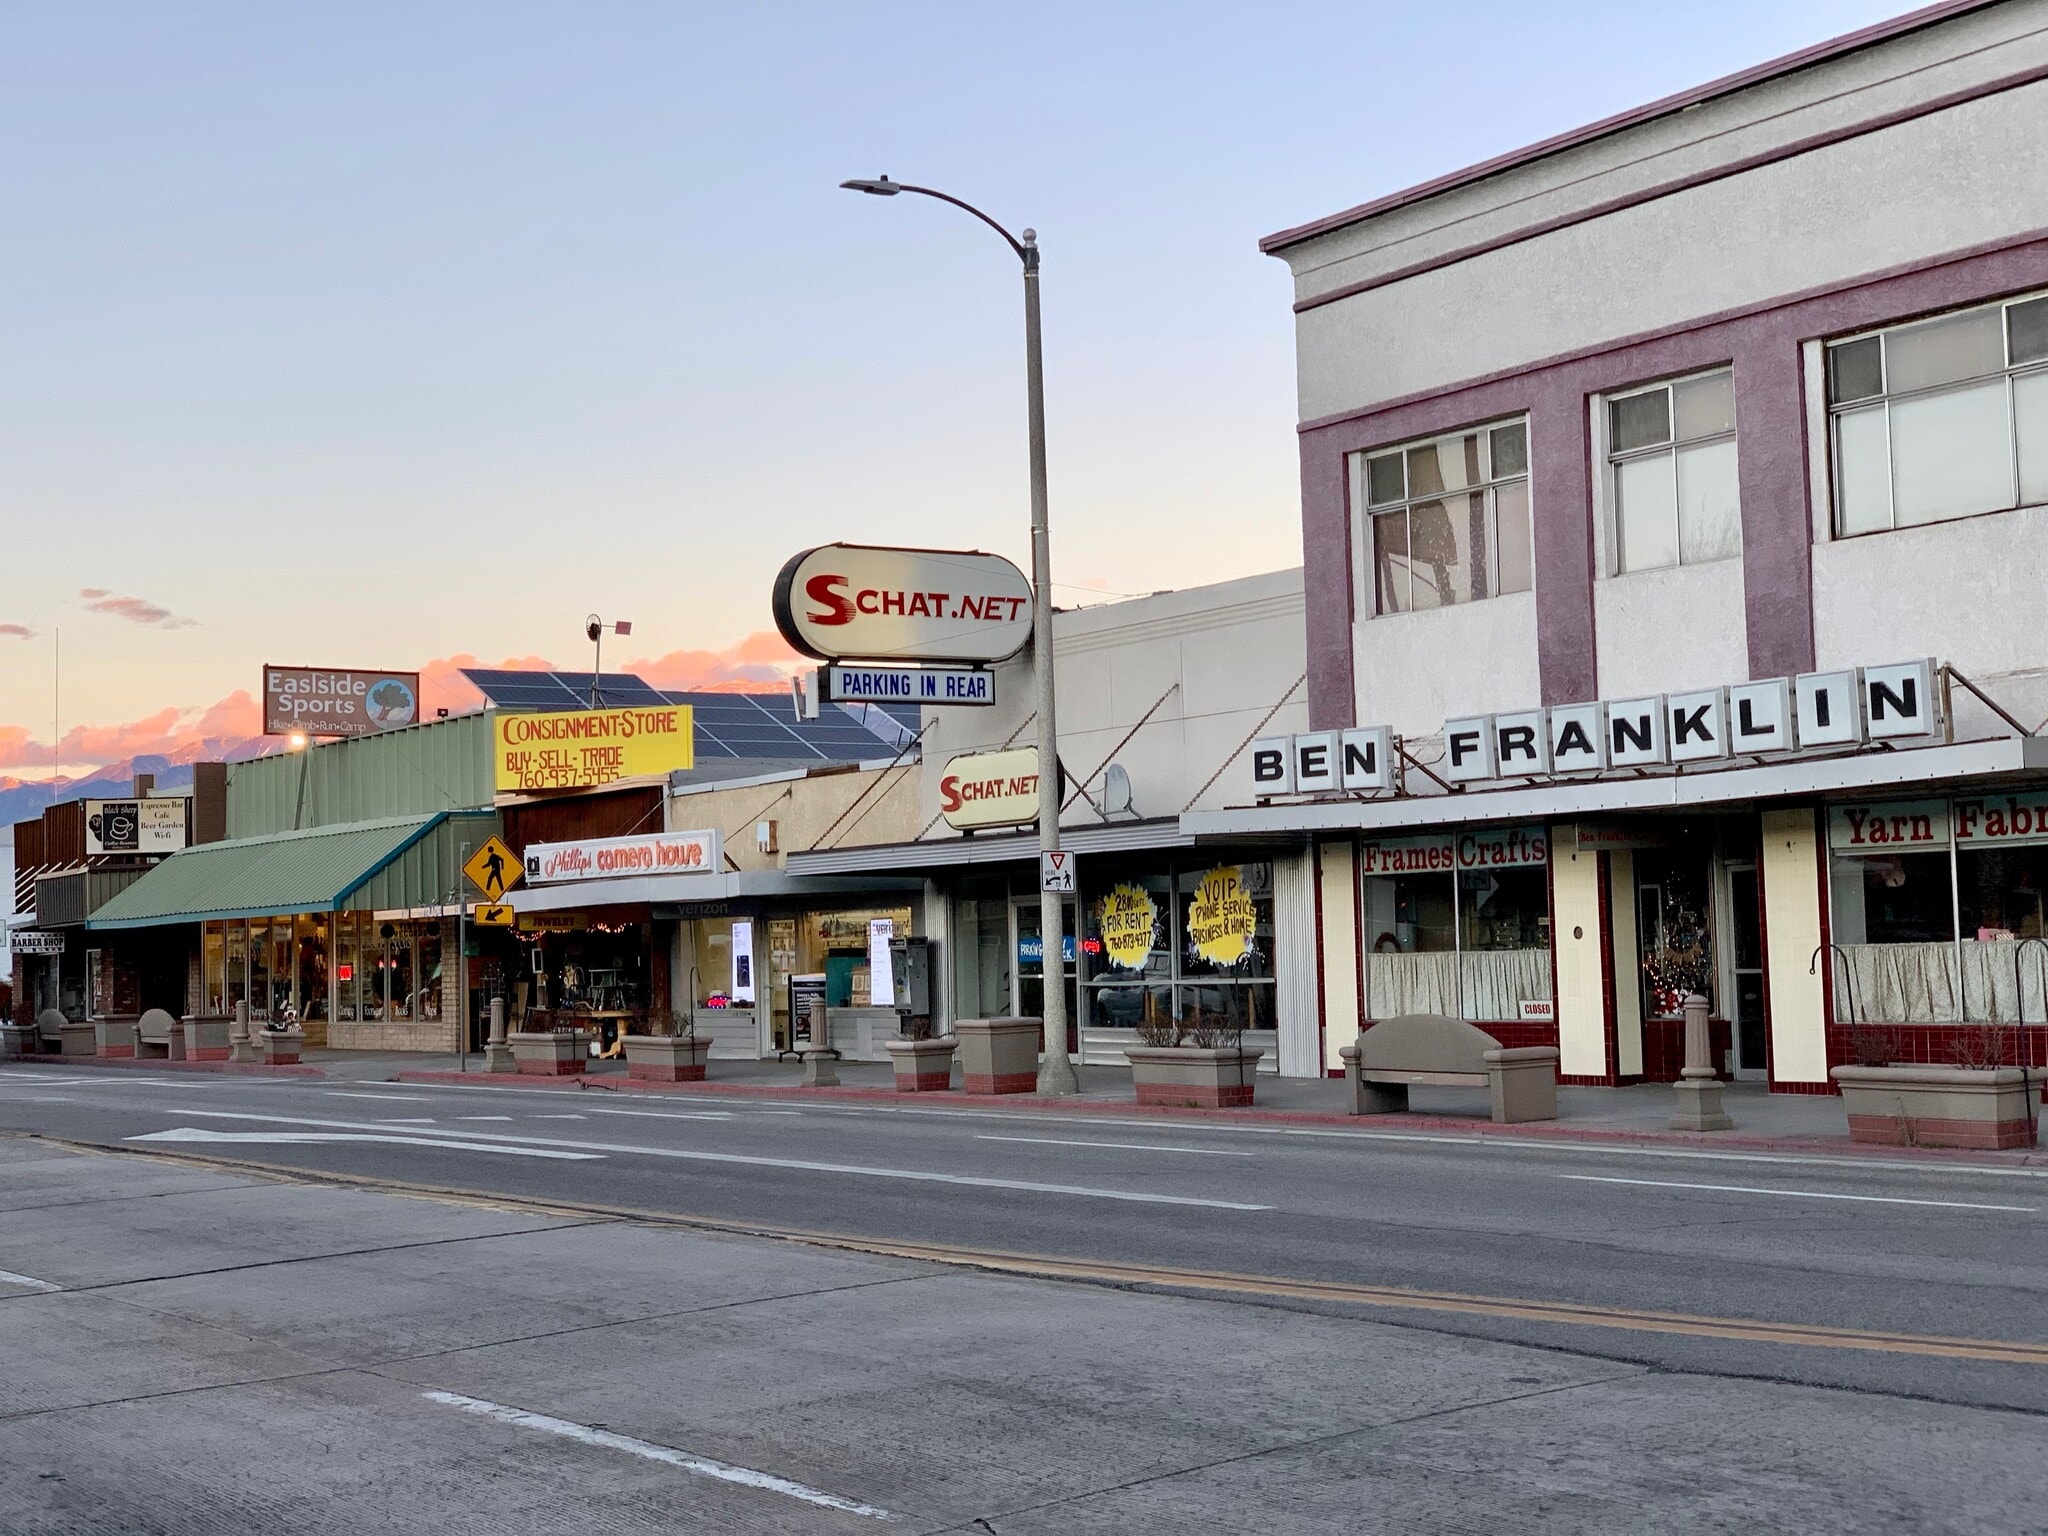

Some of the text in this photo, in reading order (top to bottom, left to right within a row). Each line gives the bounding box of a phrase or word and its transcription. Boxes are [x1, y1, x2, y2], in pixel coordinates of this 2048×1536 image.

[805, 574, 1027, 626] SCHAT.NET
[268, 672, 367, 696] Eastside
[842, 673, 986, 698] PARKING IN REAR
[278, 694, 356, 719] Sports
[1254, 677, 1919, 781] BEN FRANKLIN
[514, 766, 620, 789] 760-937-5455
[940, 775, 1040, 812] SCHAT.NET
[158, 821, 184, 829] Garden
[1843, 807, 1934, 844] Yarn
[544, 840, 703, 878] Phillips camera house
[1363, 831, 1546, 873] Frames Crafts
[1204, 877, 1237, 904] VOIP
[678, 902, 729, 915] verizon
[1195, 898, 1257, 924] PHONE SERVICE
[1106, 912, 1149, 933] FOR RENT
[1192, 916, 1253, 945] BUSINESS & HOME
[11, 937, 64, 948] BARBER SHOP
[1524, 1004, 1551, 1015] CLOSED
